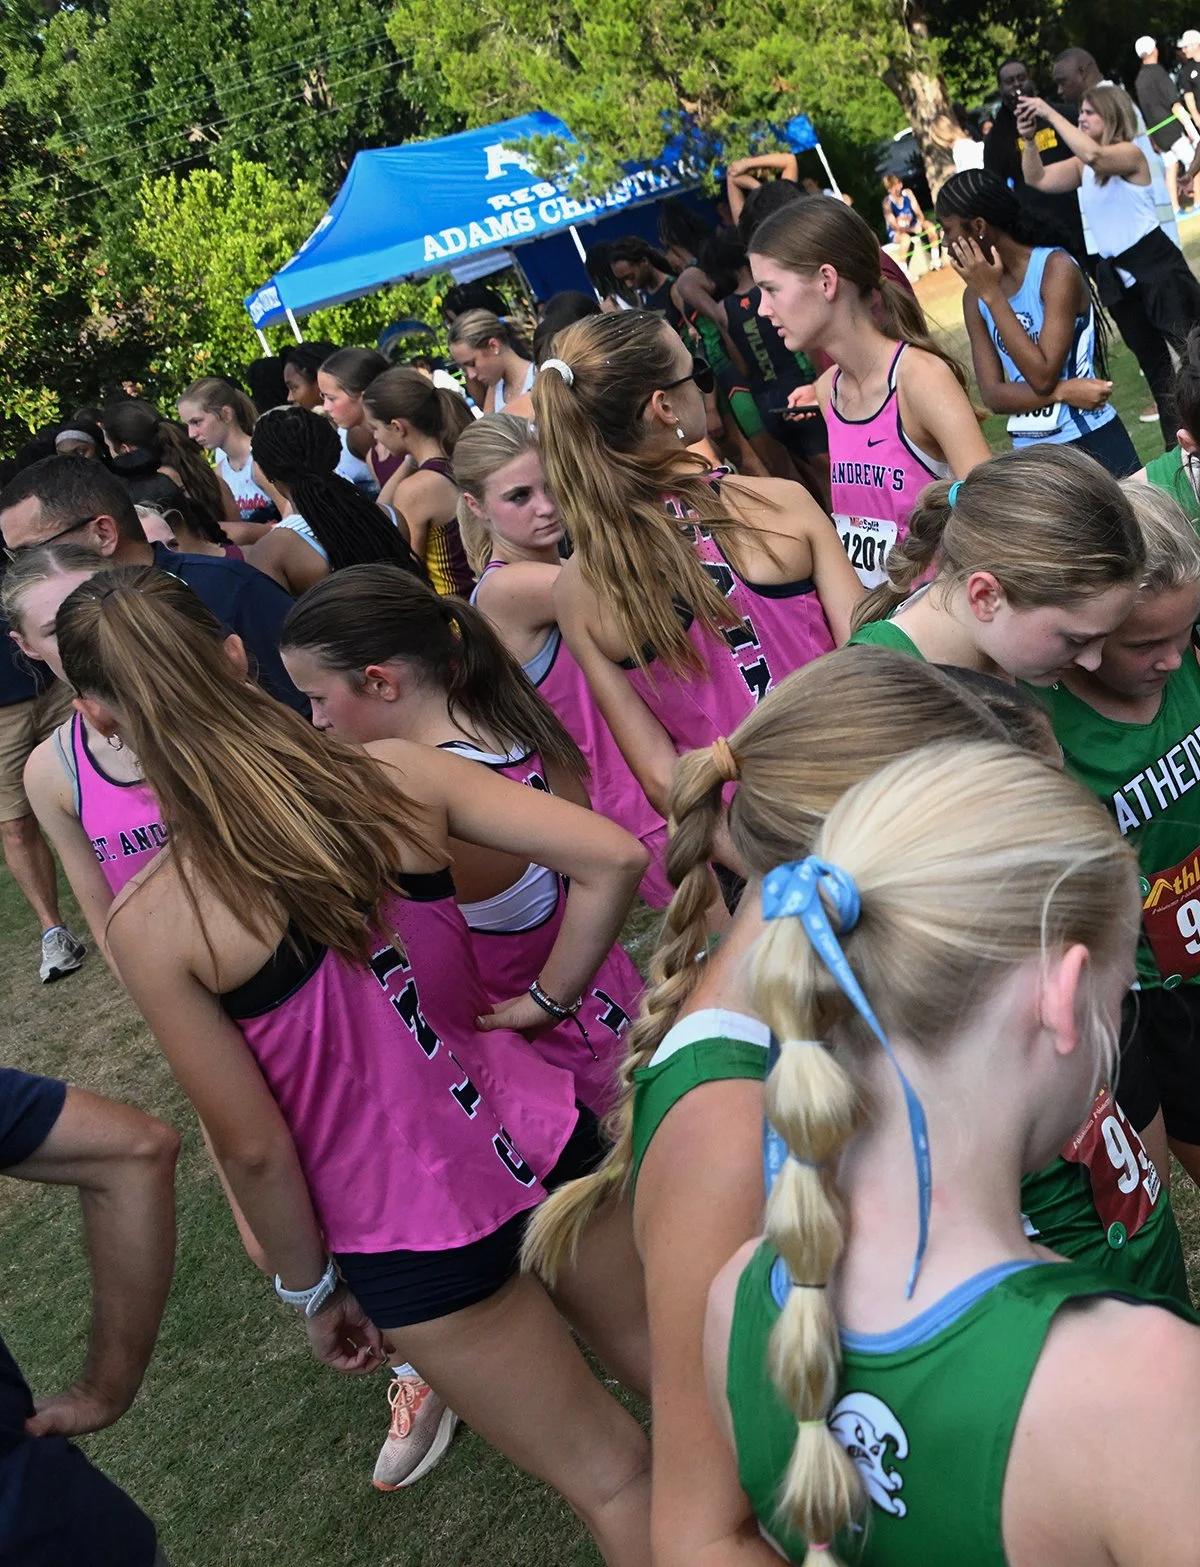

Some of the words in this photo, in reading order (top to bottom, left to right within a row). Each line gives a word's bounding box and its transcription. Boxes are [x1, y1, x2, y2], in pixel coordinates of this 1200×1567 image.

[423, 206, 536, 261] ADAMS
[831, 461, 905, 492] ANDREW'S
[842, 531, 887, 573] 1201
